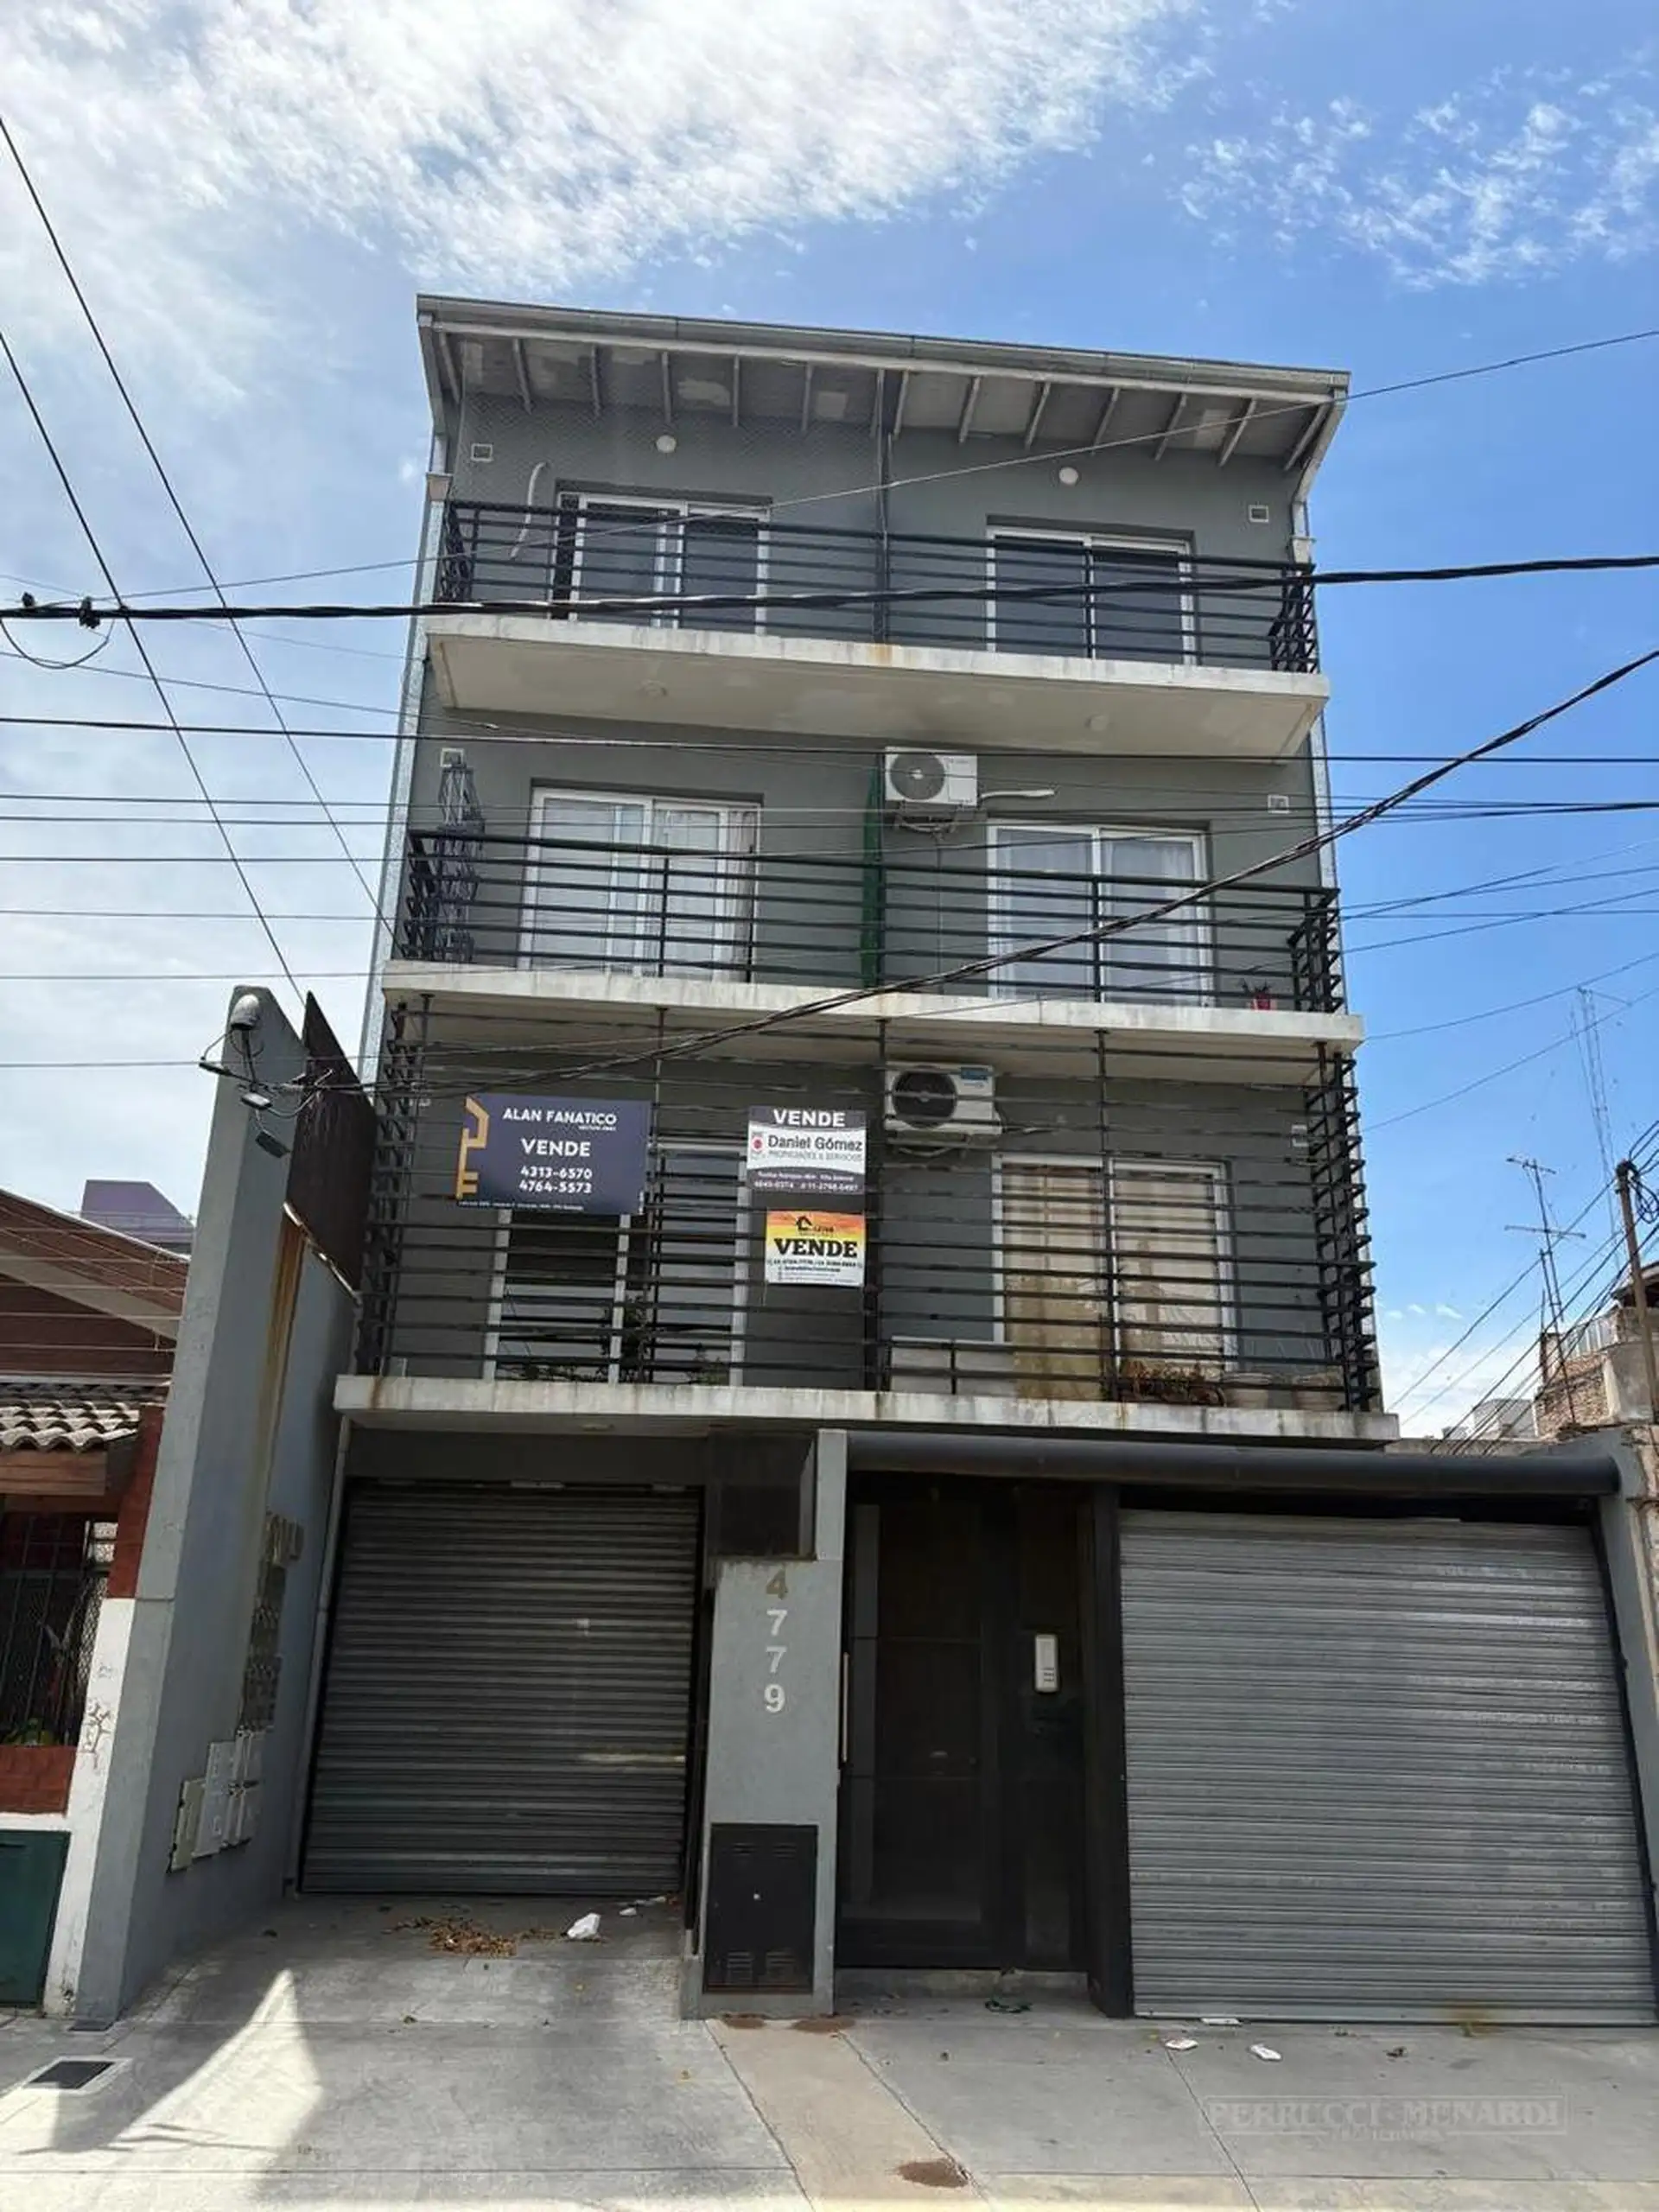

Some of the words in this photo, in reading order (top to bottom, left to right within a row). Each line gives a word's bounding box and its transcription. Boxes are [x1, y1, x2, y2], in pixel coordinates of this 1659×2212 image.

[503, 1107, 542, 1122] ALAN
[546, 1109, 618, 1126] FANATICO
[773, 1109, 846, 1128] VENDE
[520, 1138, 592, 1157] VENDE
[767, 1135, 811, 1150] Daniel
[814, 1136, 863, 1152] Gómez
[520, 1165, 594, 1180] 4313-6570
[773, 1237, 858, 1258] VENDE
[764, 1565, 788, 1713] 4779
